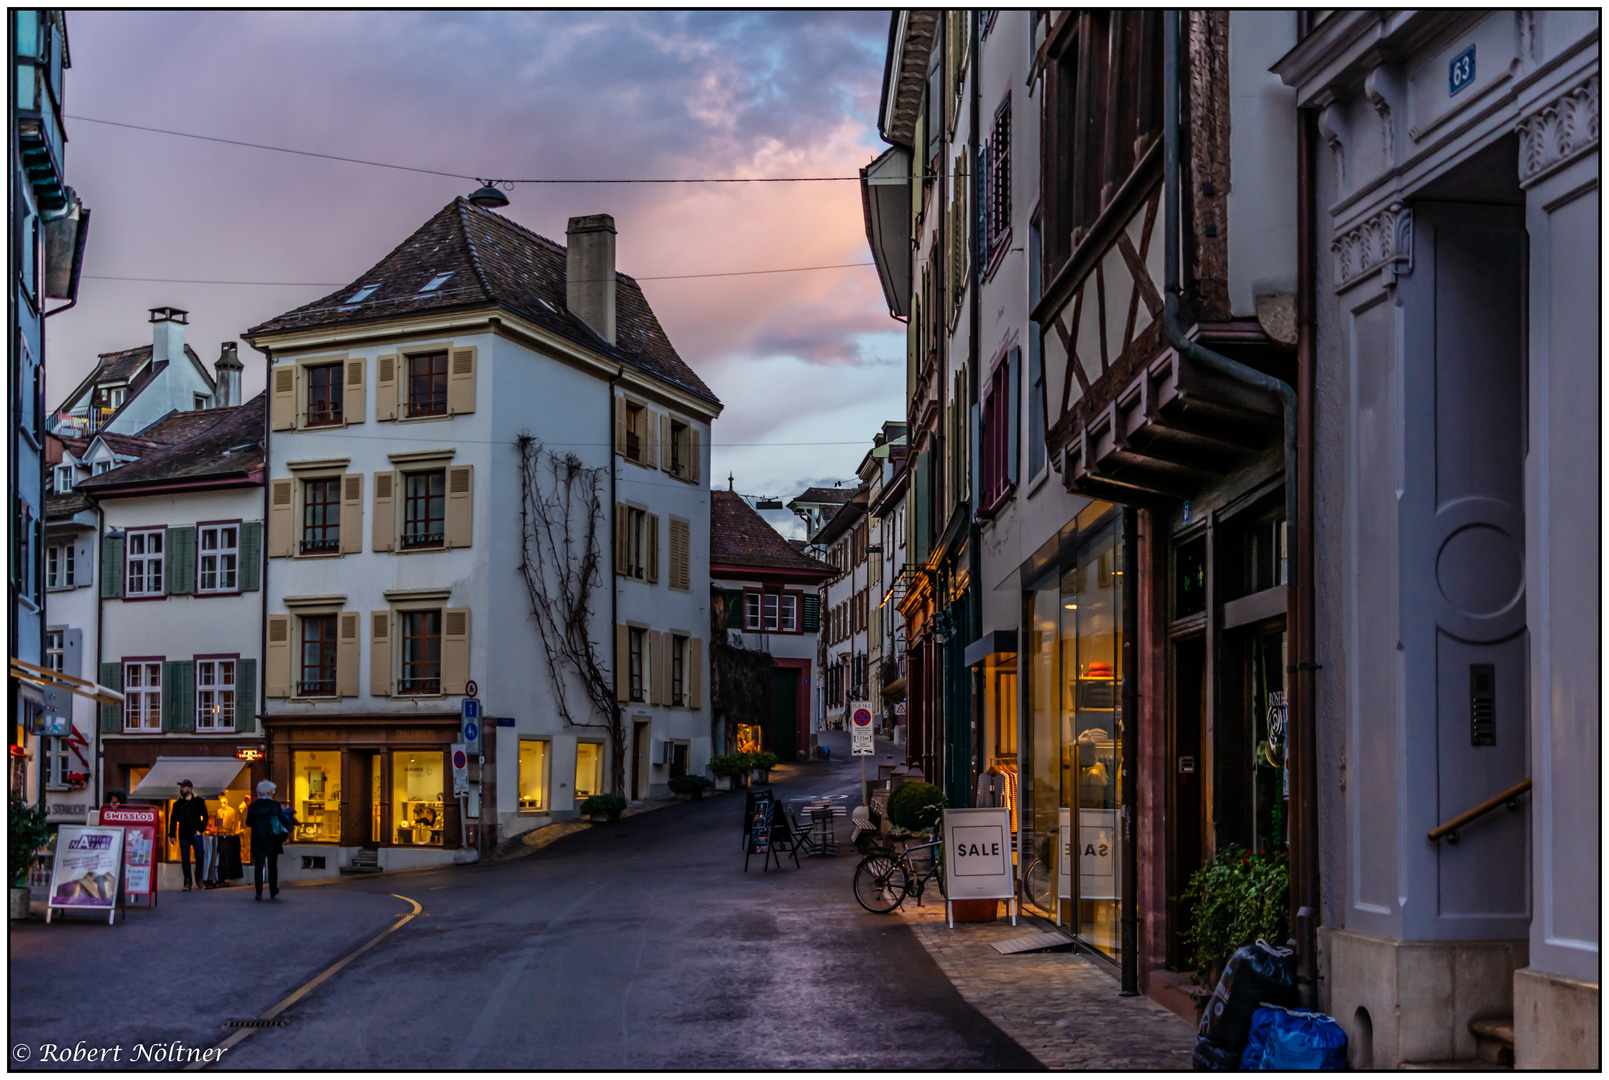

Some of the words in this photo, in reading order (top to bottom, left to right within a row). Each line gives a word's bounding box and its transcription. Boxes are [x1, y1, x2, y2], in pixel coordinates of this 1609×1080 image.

[1453, 55, 1470, 86] 63
[104, 811, 154, 822] SWISSLOS
[957, 843, 1000, 857] SALE
